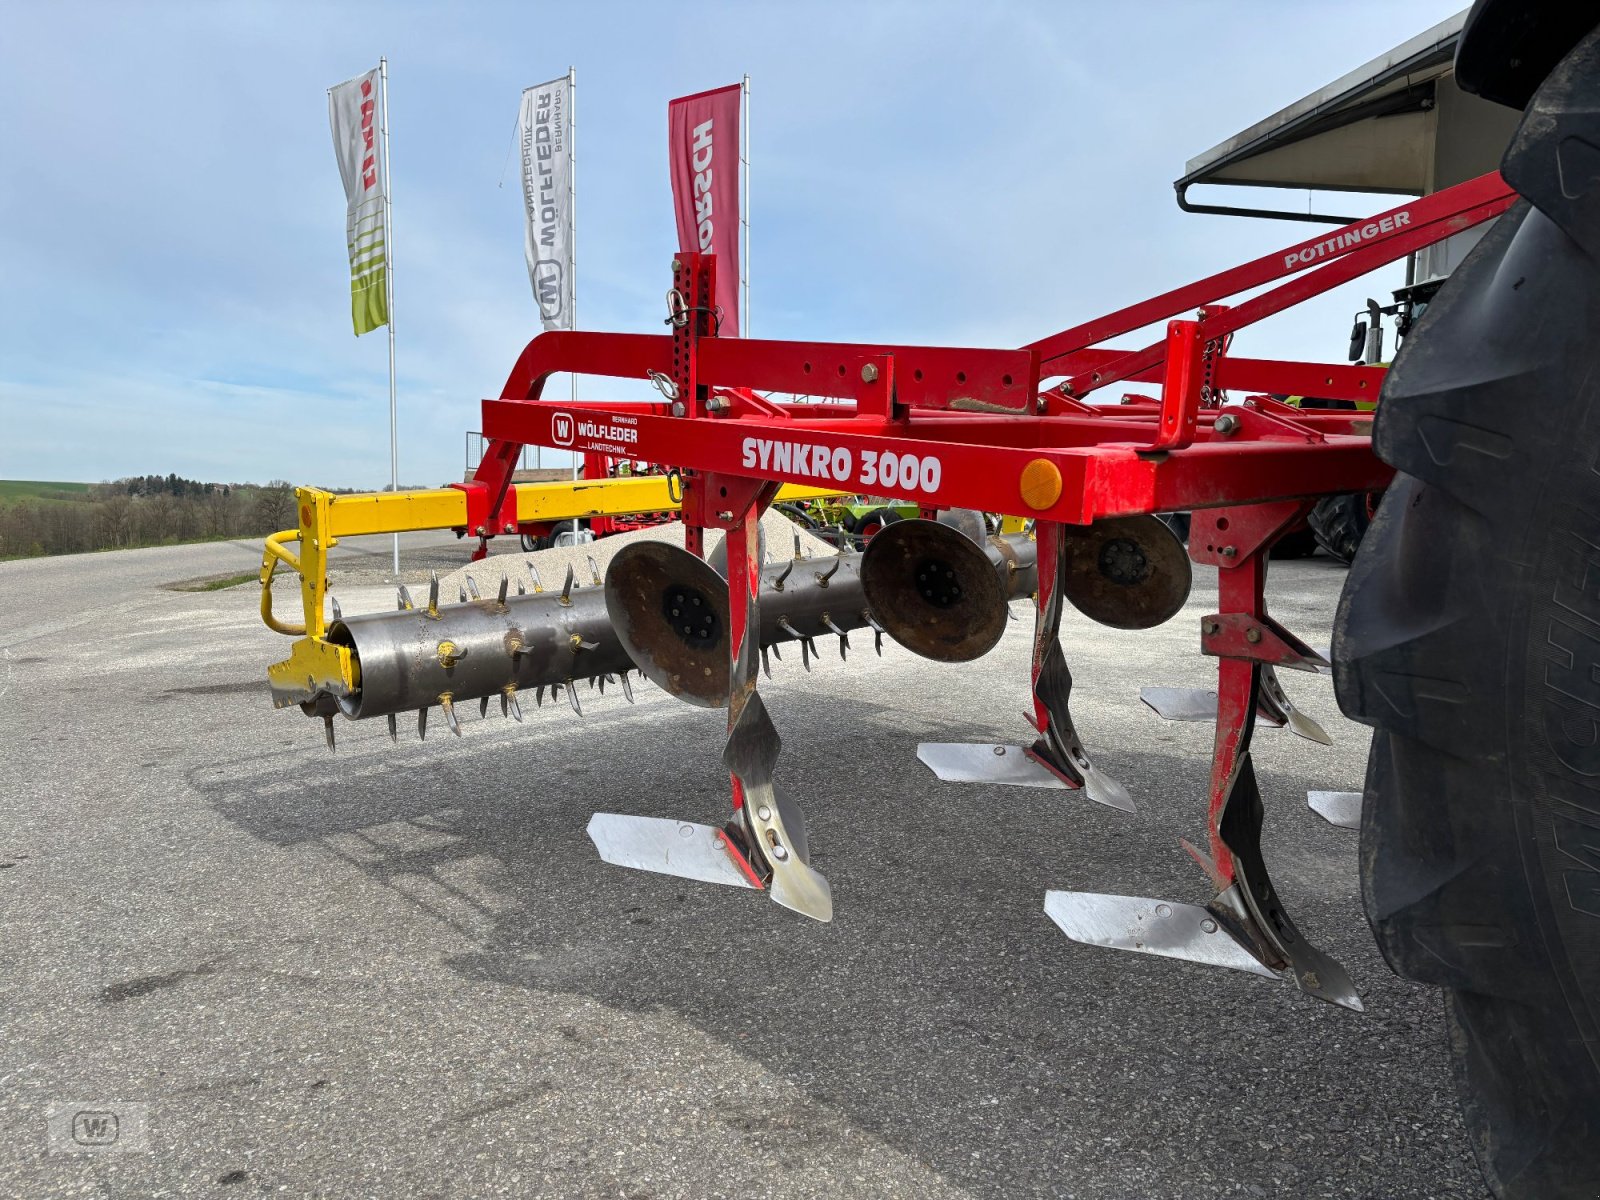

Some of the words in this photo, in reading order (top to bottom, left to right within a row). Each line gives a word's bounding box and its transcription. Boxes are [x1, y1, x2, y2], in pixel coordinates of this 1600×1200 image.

[1284, 211, 1412, 269] PÖTTINGER
[577, 419, 638, 443] WÖLFLEDER
[612, 415, 638, 425] BERNHARD
[587, 441, 627, 455] LANDTECHNIK
[742, 437, 852, 482] SYNKRO
[860, 449, 941, 493] 3000
